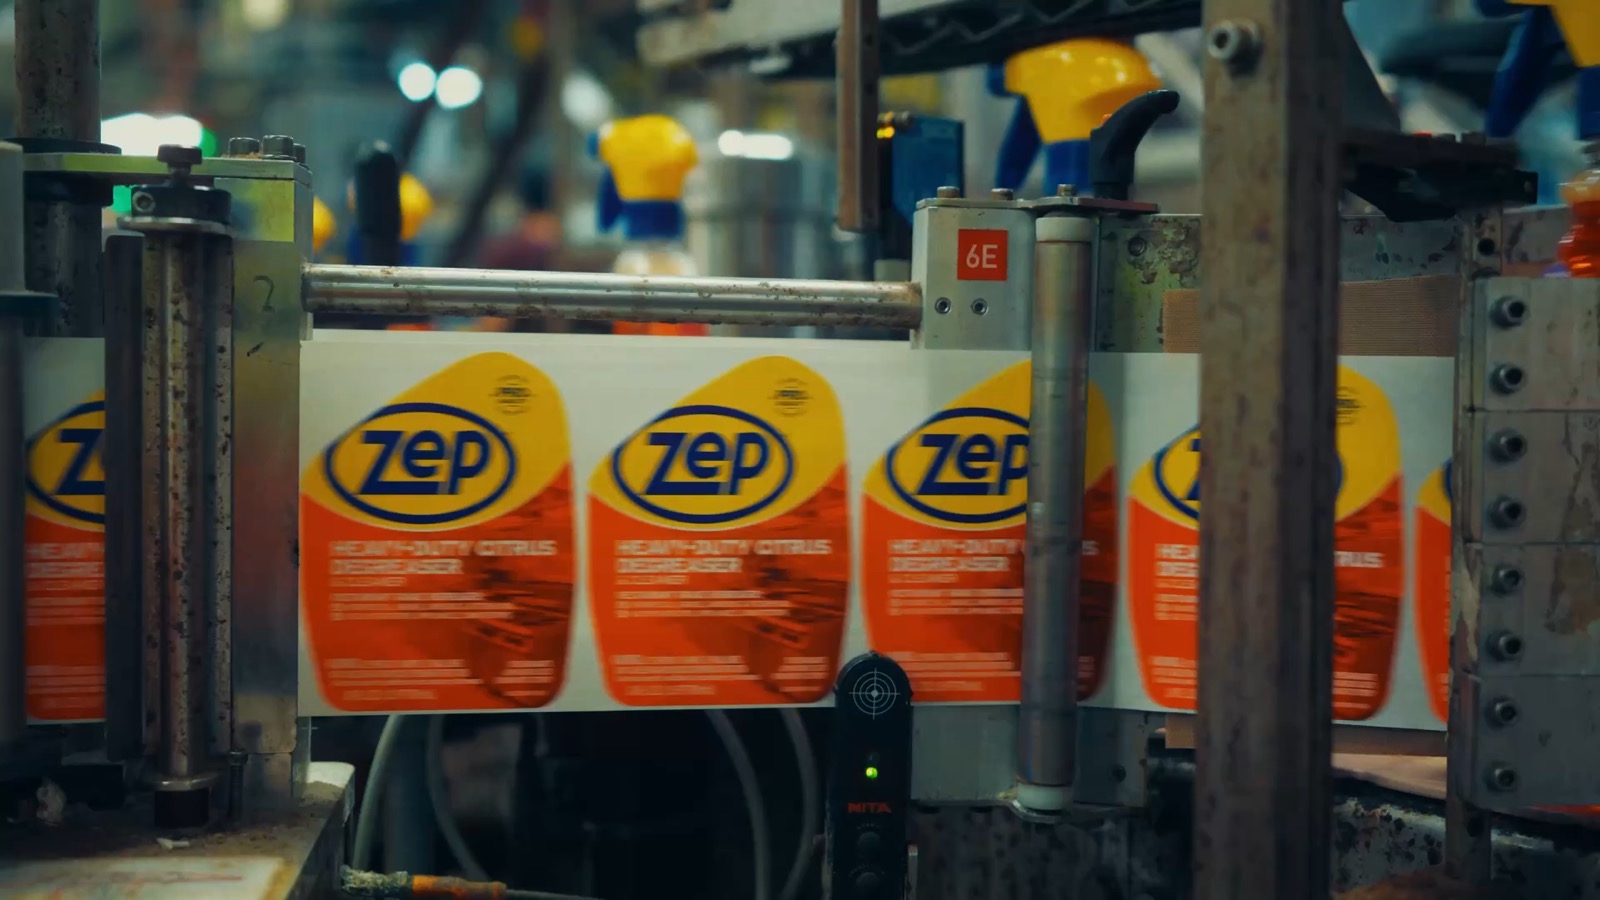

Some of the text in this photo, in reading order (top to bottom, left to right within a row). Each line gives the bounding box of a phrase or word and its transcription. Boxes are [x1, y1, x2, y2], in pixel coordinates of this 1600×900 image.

[966, 244, 998, 268] 6E
[330, 540, 558, 556] HEAVY-DUTY CITRUS
[615, 539, 832, 555] HEAVY-DUTY CITRUS
[330, 559, 464, 574] DEGREASER
[615, 557, 743, 573] DEGREASER
